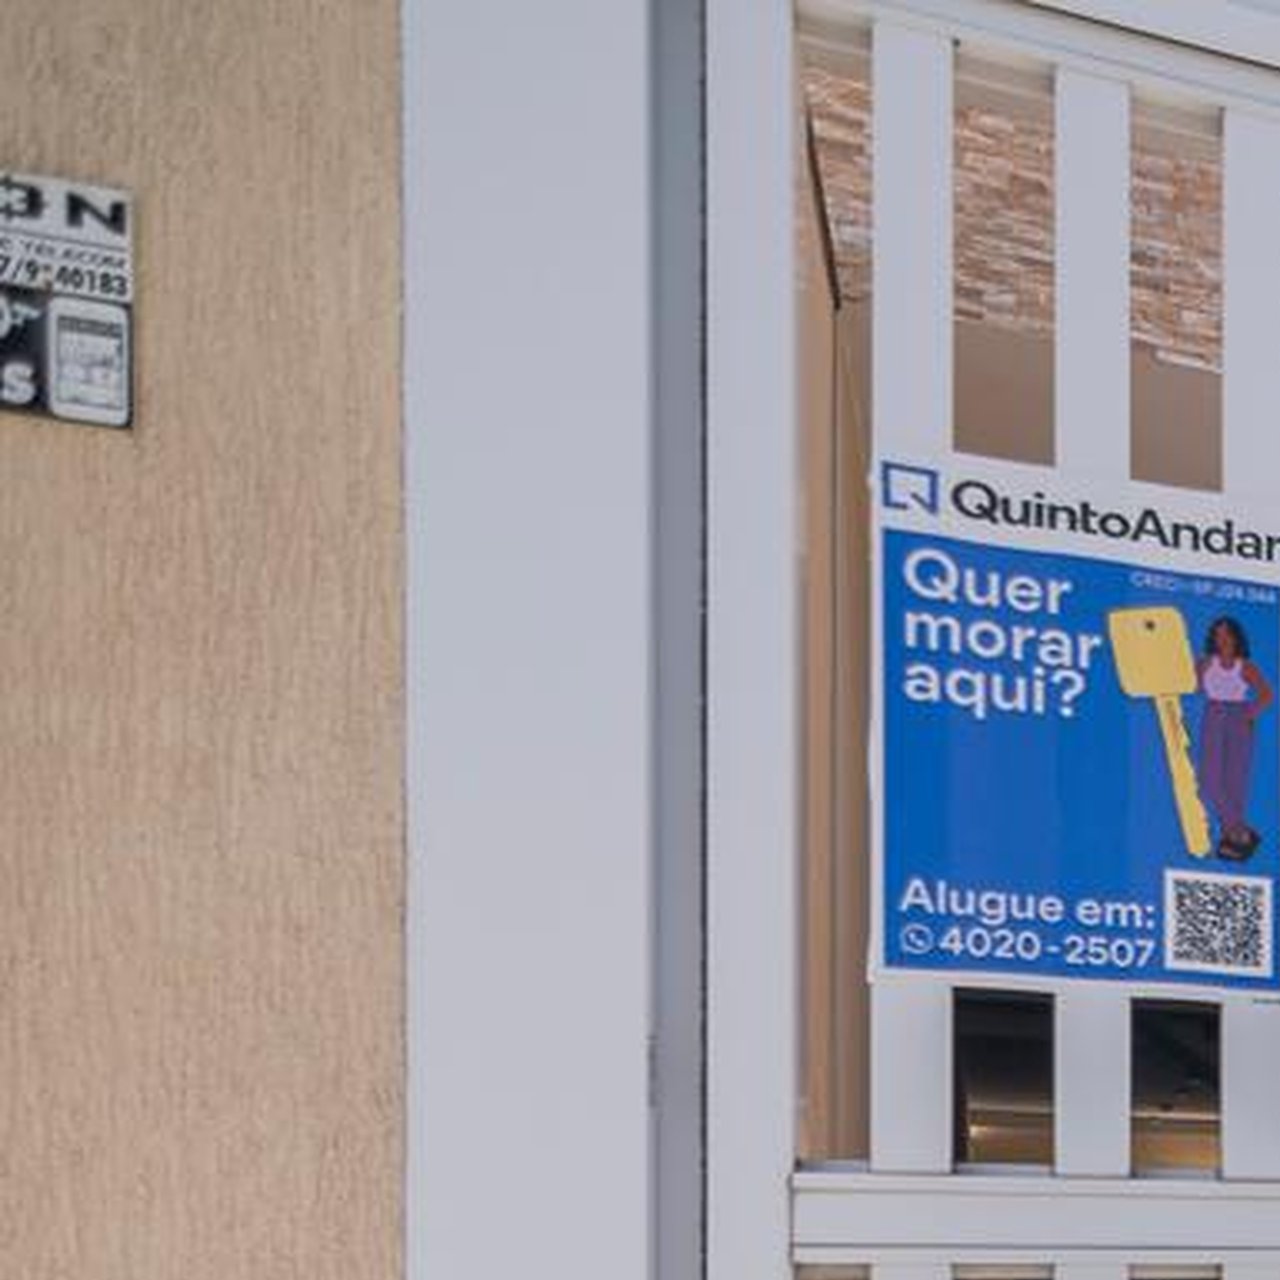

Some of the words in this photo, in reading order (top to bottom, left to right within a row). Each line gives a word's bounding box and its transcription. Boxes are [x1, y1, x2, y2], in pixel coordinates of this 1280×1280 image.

[904, 548, 1071, 614] Quer
[905, 611, 1101, 669] morar
[904, 663, 1085, 719] aqui?
[901, 878, 1064, 927] Alugue
[1076, 902, 1156, 929] em:
